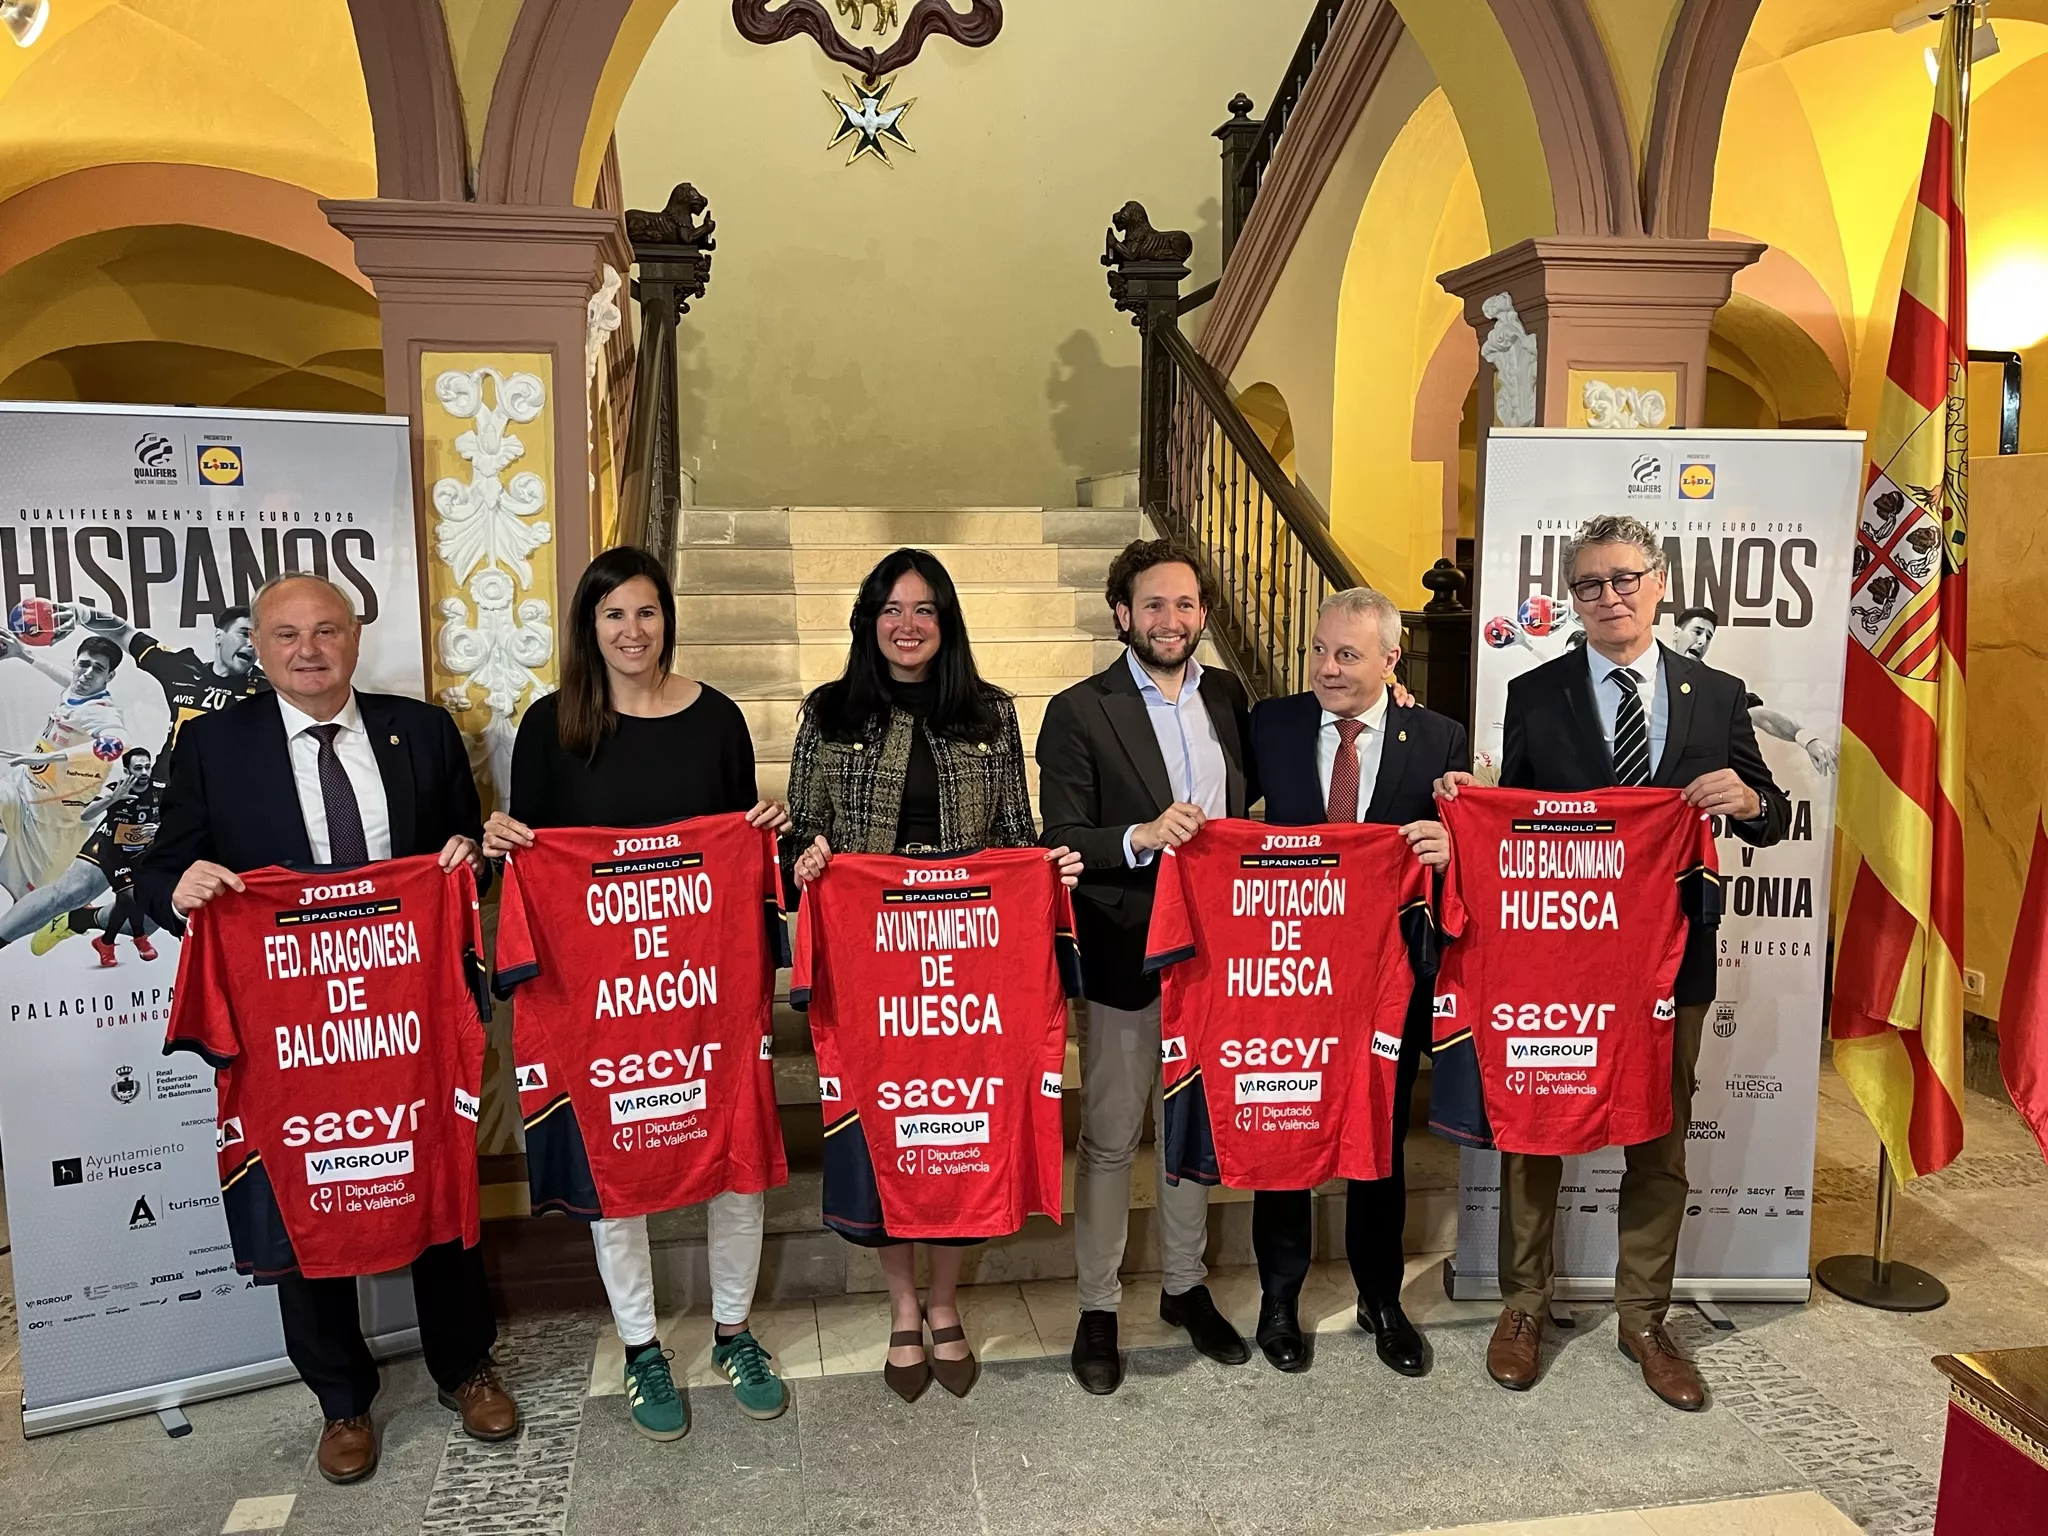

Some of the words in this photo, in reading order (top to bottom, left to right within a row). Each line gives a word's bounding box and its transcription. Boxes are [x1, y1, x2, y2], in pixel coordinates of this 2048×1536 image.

[134, 468, 177, 478] QUALIFIERS
[1628, 485, 1661, 493] QUALIFIERS
[20, 509, 132, 520] QUALIFIERS
[148, 510, 202, 521] MEN'S
[217, 511, 245, 521] EHF
[260, 512, 299, 521] EURO
[314, 512, 353, 522] 2026
[1538, 520, 1577, 529] QUALI
[1646, 522, 1676, 530] EN'S
[1689, 522, 1712, 530] EHF
[1723, 523, 1756, 531] EURO
[1768, 523, 1802, 532] 2026
[0, 527, 378, 628] HISPANOS
[1517, 534, 1817, 628] HIANOS
[173, 695, 194, 704] AVIS
[1534, 800, 1597, 815] Joma
[138, 812, 146, 823] 9
[613, 834, 681, 856] Joma
[1261, 835, 1322, 850] Joma
[1500, 839, 1535, 878] CLUB
[1539, 840, 1624, 879] BALONMANO
[1742, 847, 1754, 867] V
[615, 860, 679, 873] SPAGNOLO
[903, 868, 969, 886] Joma
[299, 880, 376, 905] Joma
[586, 872, 712, 926] GOBIERNO
[1232, 870, 1346, 917] DIPUTACIÓN
[1720, 876, 1812, 918] TONIA
[302, 907, 375, 921] SPAGNOLO
[1501, 890, 1618, 930] HUESCA
[876, 906, 999, 952] AYUNTAMIENTO
[1272, 920, 1301, 951] DE
[264, 935, 307, 980] FED.
[311, 921, 421, 976] ARAGONESA
[634, 925, 669, 960] DE
[1742, 940, 1811, 956] HUESCA
[921, 955, 954, 987] DE
[1228, 957, 1333, 997] HUESCA
[327, 977, 367, 1013] DE
[595, 960, 717, 1019] ARAGÓN
[11, 995, 113, 1021] PALACIO
[132, 987, 174, 1008] MPA
[97, 1008, 169, 1028] DOMINGO
[879, 994, 1003, 1037] HUESCA
[1491, 1003, 1615, 1034] sacyr
[275, 1011, 421, 1070] BALONMANO
[1373, 1038, 1400, 1056] helv
[1219, 1037, 1338, 1068] sacyr
[1511, 1045, 1593, 1059] VARGROUP
[156, 1069, 172, 1077] Real
[589, 1043, 721, 1088] sacyr
[157, 1074, 198, 1084] Federación
[1536, 1071, 1587, 1082] Diputació
[157, 1082, 191, 1091] Española
[168, 1087, 211, 1098] Balonmano
[877, 1077, 1003, 1110] sacyr
[1240, 1079, 1318, 1095] VARGROUP
[1536, 1085, 1549, 1094] de
[1551, 1084, 1596, 1094] València
[455, 1096, 479, 1116] helv
[615, 1087, 702, 1115] VARGROUP
[1262, 1106, 1312, 1117] Diputació
[182, 1118, 216, 1127] PATROCINA
[282, 1098, 426, 1147] sacyr
[645, 1116, 697, 1134] Diputació
[900, 1120, 985, 1138] VARGROUP
[1262, 1121, 1276, 1131] de
[1278, 1120, 1319, 1130] València
[1690, 1121, 1718, 1130] ERNO
[645, 1137, 661, 1148] de
[663, 1129, 708, 1146] València
[1689, 1131, 1725, 1139] RAGON
[86, 1143, 184, 1168] Ayuntamiento
[311, 1150, 409, 1175] VARGROUP
[928, 1147, 980, 1161] Diputació
[87, 1171, 103, 1182] de
[108, 1161, 162, 1178] Huesca
[928, 1164, 942, 1174] de
[944, 1161, 989, 1174] València
[345, 1179, 405, 1196] Diputació
[1710, 1186, 1738, 1196] renfe
[169, 1196, 219, 1211] turismo
[346, 1200, 362, 1211] de
[363, 1193, 415, 1210] València
[189, 1243, 232, 1255] PATROCINADO
[150, 1271, 184, 1285] Joma
[196, 1266, 228, 1276] helvetia
